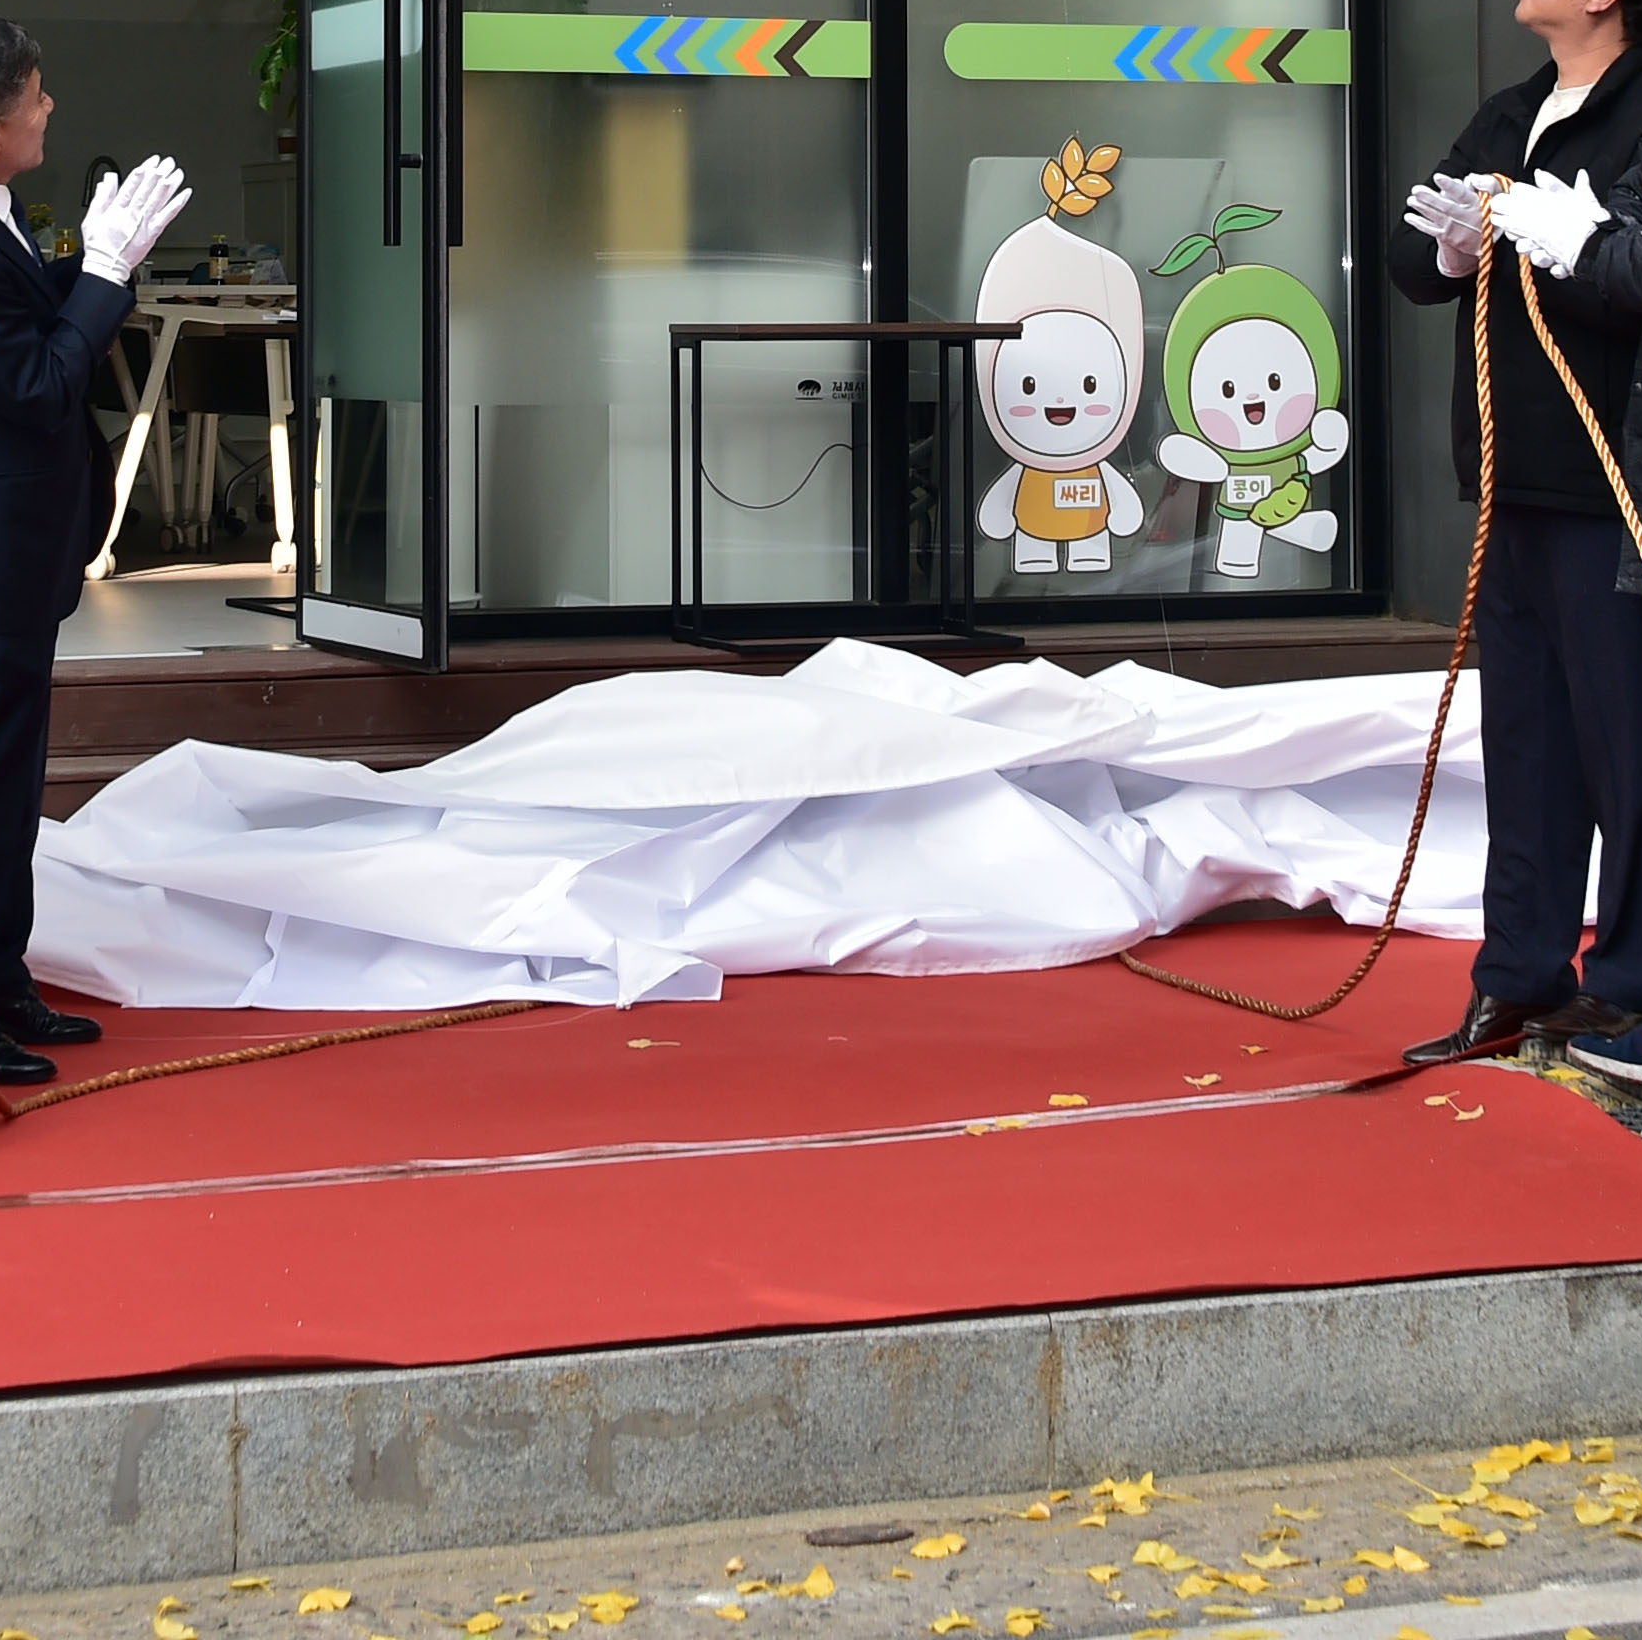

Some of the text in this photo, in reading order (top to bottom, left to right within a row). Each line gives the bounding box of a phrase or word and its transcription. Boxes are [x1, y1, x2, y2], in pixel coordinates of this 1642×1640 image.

[832, 381, 865, 392] 김제시
[1059, 483, 1098, 505] 싸리
[1231, 478, 1266, 499] 콩이
